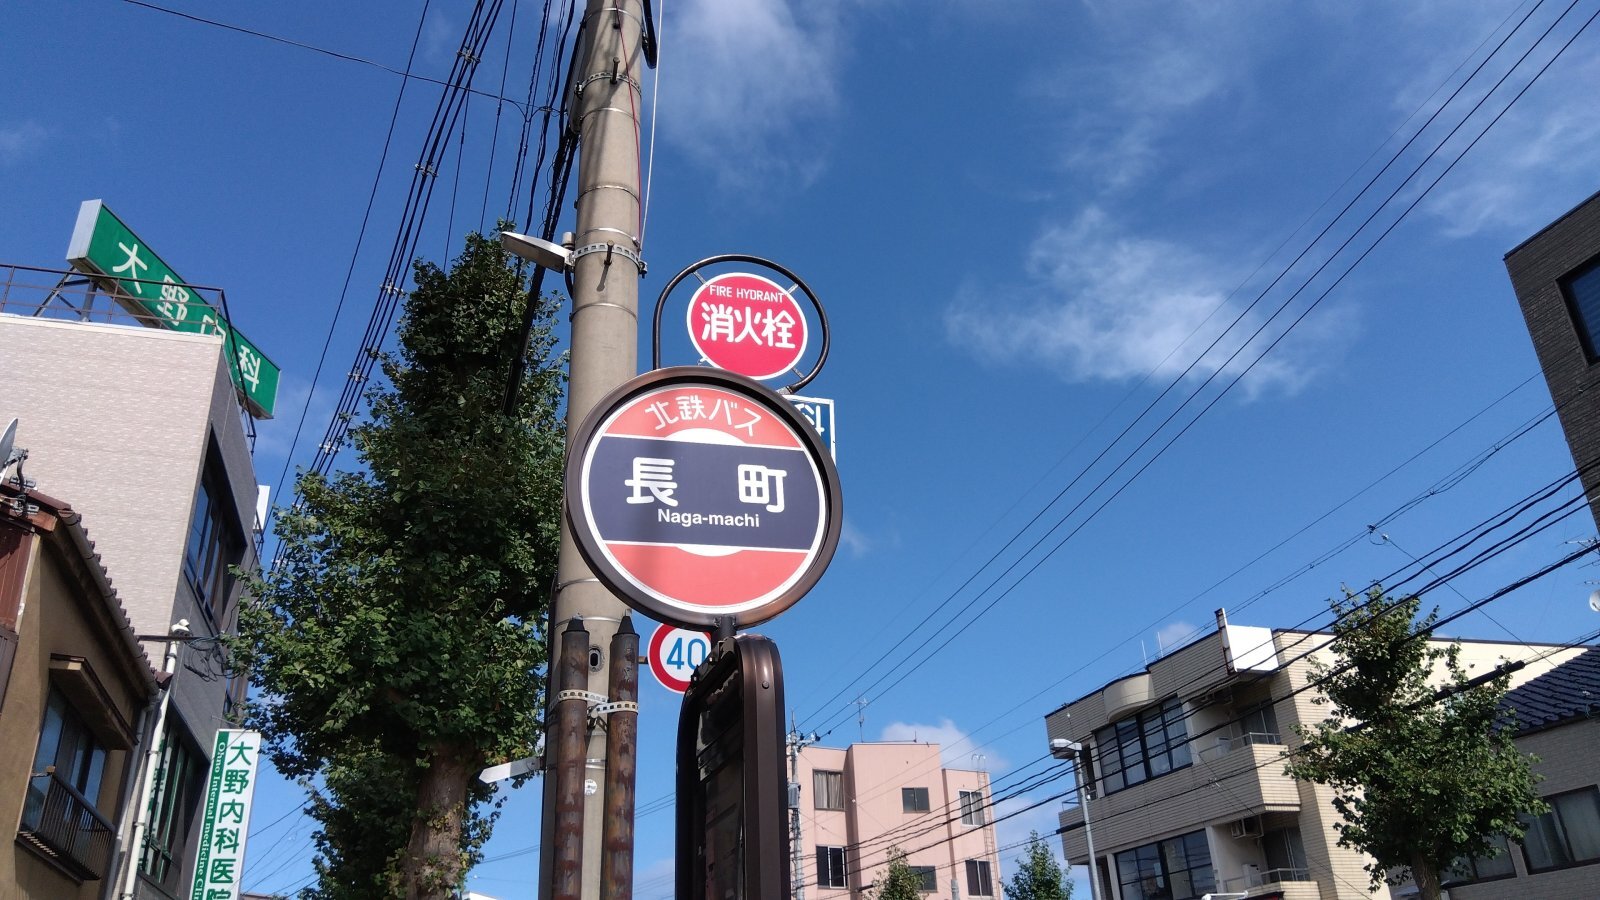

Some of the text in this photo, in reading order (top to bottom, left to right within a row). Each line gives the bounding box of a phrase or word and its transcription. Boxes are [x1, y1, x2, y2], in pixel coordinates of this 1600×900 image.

[709, 284, 784, 304] FIRE HYDRANT
[701, 301, 796, 349] 消火栓
[645, 395, 762, 437] 北鉄バス
[657, 508, 760, 528] Naga-machi
[666, 637, 706, 670] 40
[214, 741, 226, 773] Ohno
[206, 776, 221, 820] Internal
[197, 822, 211, 875] medicine
